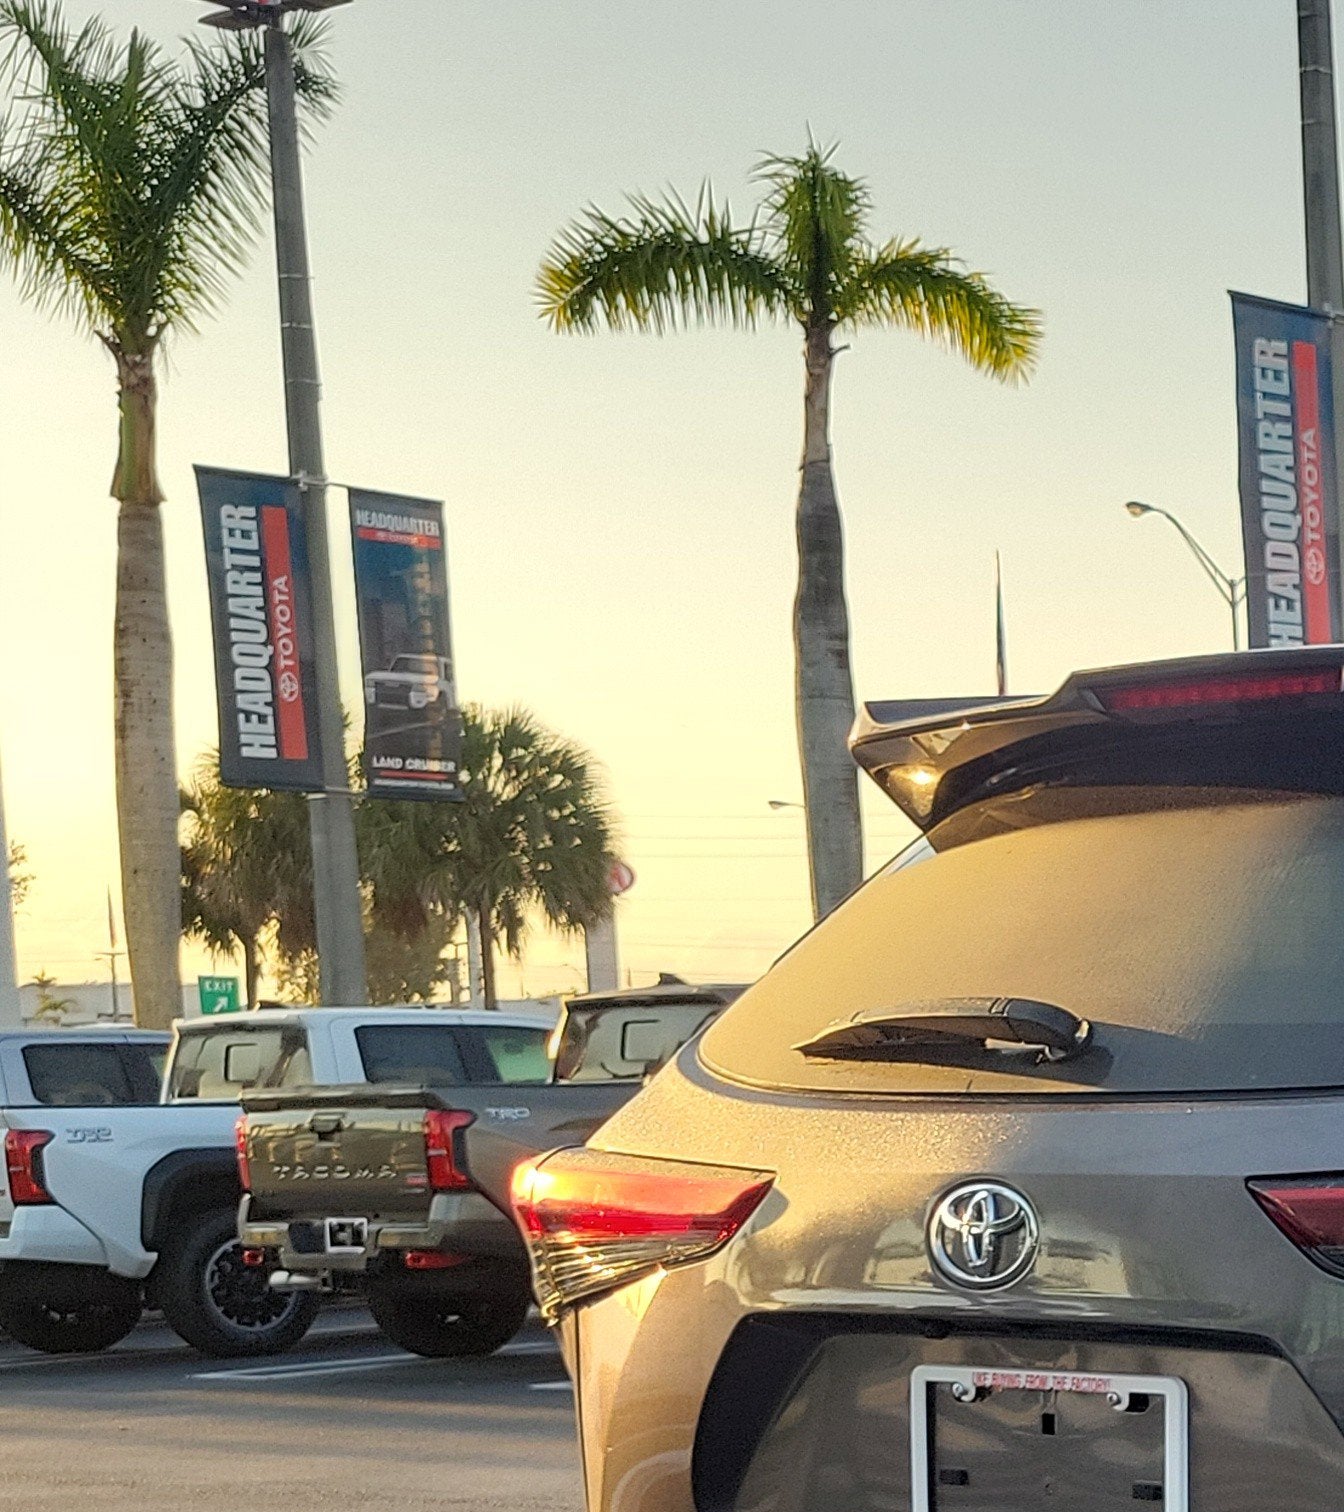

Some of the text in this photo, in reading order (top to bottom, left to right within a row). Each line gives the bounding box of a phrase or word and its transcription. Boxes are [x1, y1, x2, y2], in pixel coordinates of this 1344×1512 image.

[1252, 337, 1304, 648] HEADQUARTER
[1300, 427, 1324, 545] TOYOTA
[356, 509, 440, 536] HEADQUARTER
[220, 503, 278, 760] HEADQUARTER
[271, 575, 298, 668] TOYOTA
[372, 756, 403, 769] LAND
[205, 980, 233, 992] EXIT
[273, 1165, 397, 1180] TACOMA
